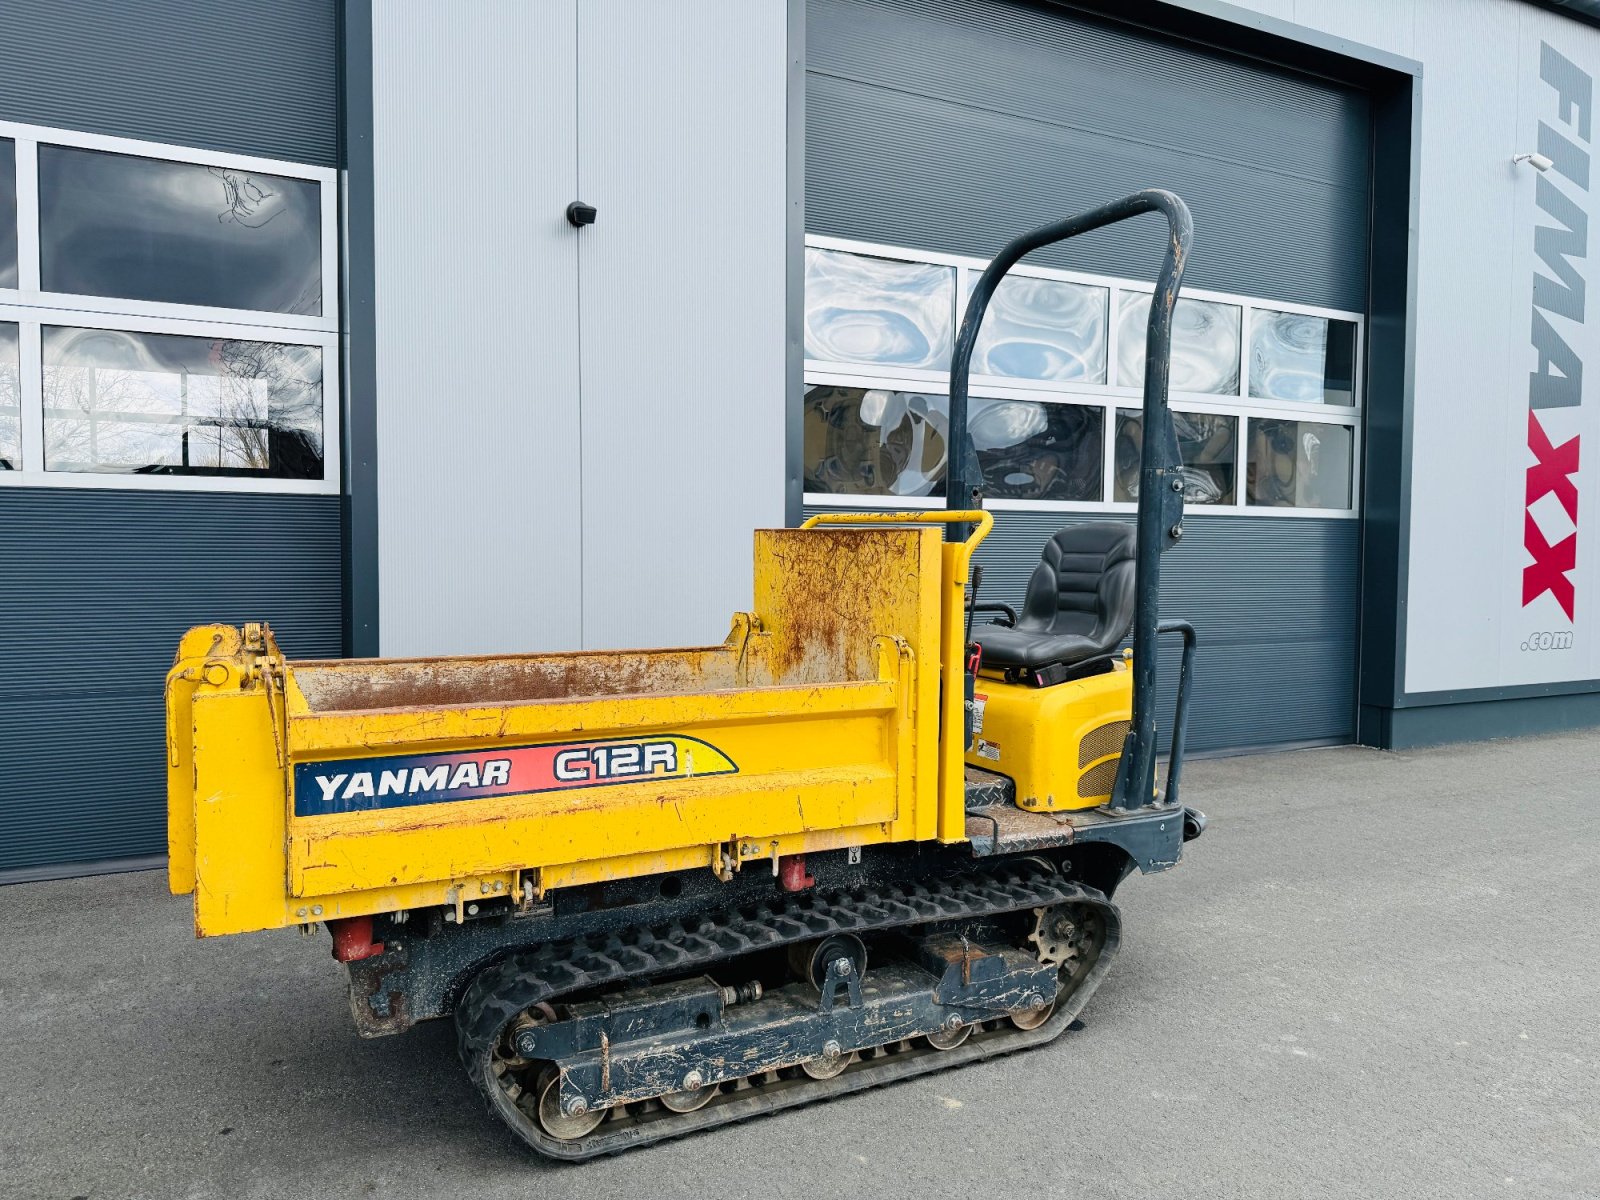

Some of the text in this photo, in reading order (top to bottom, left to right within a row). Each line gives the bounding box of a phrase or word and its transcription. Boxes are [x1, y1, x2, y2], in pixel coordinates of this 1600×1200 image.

[1522, 39, 1592, 624] FIMAXX
[1520, 630, 1574, 651] .com
[314, 742, 678, 801] YANMAR C12R
